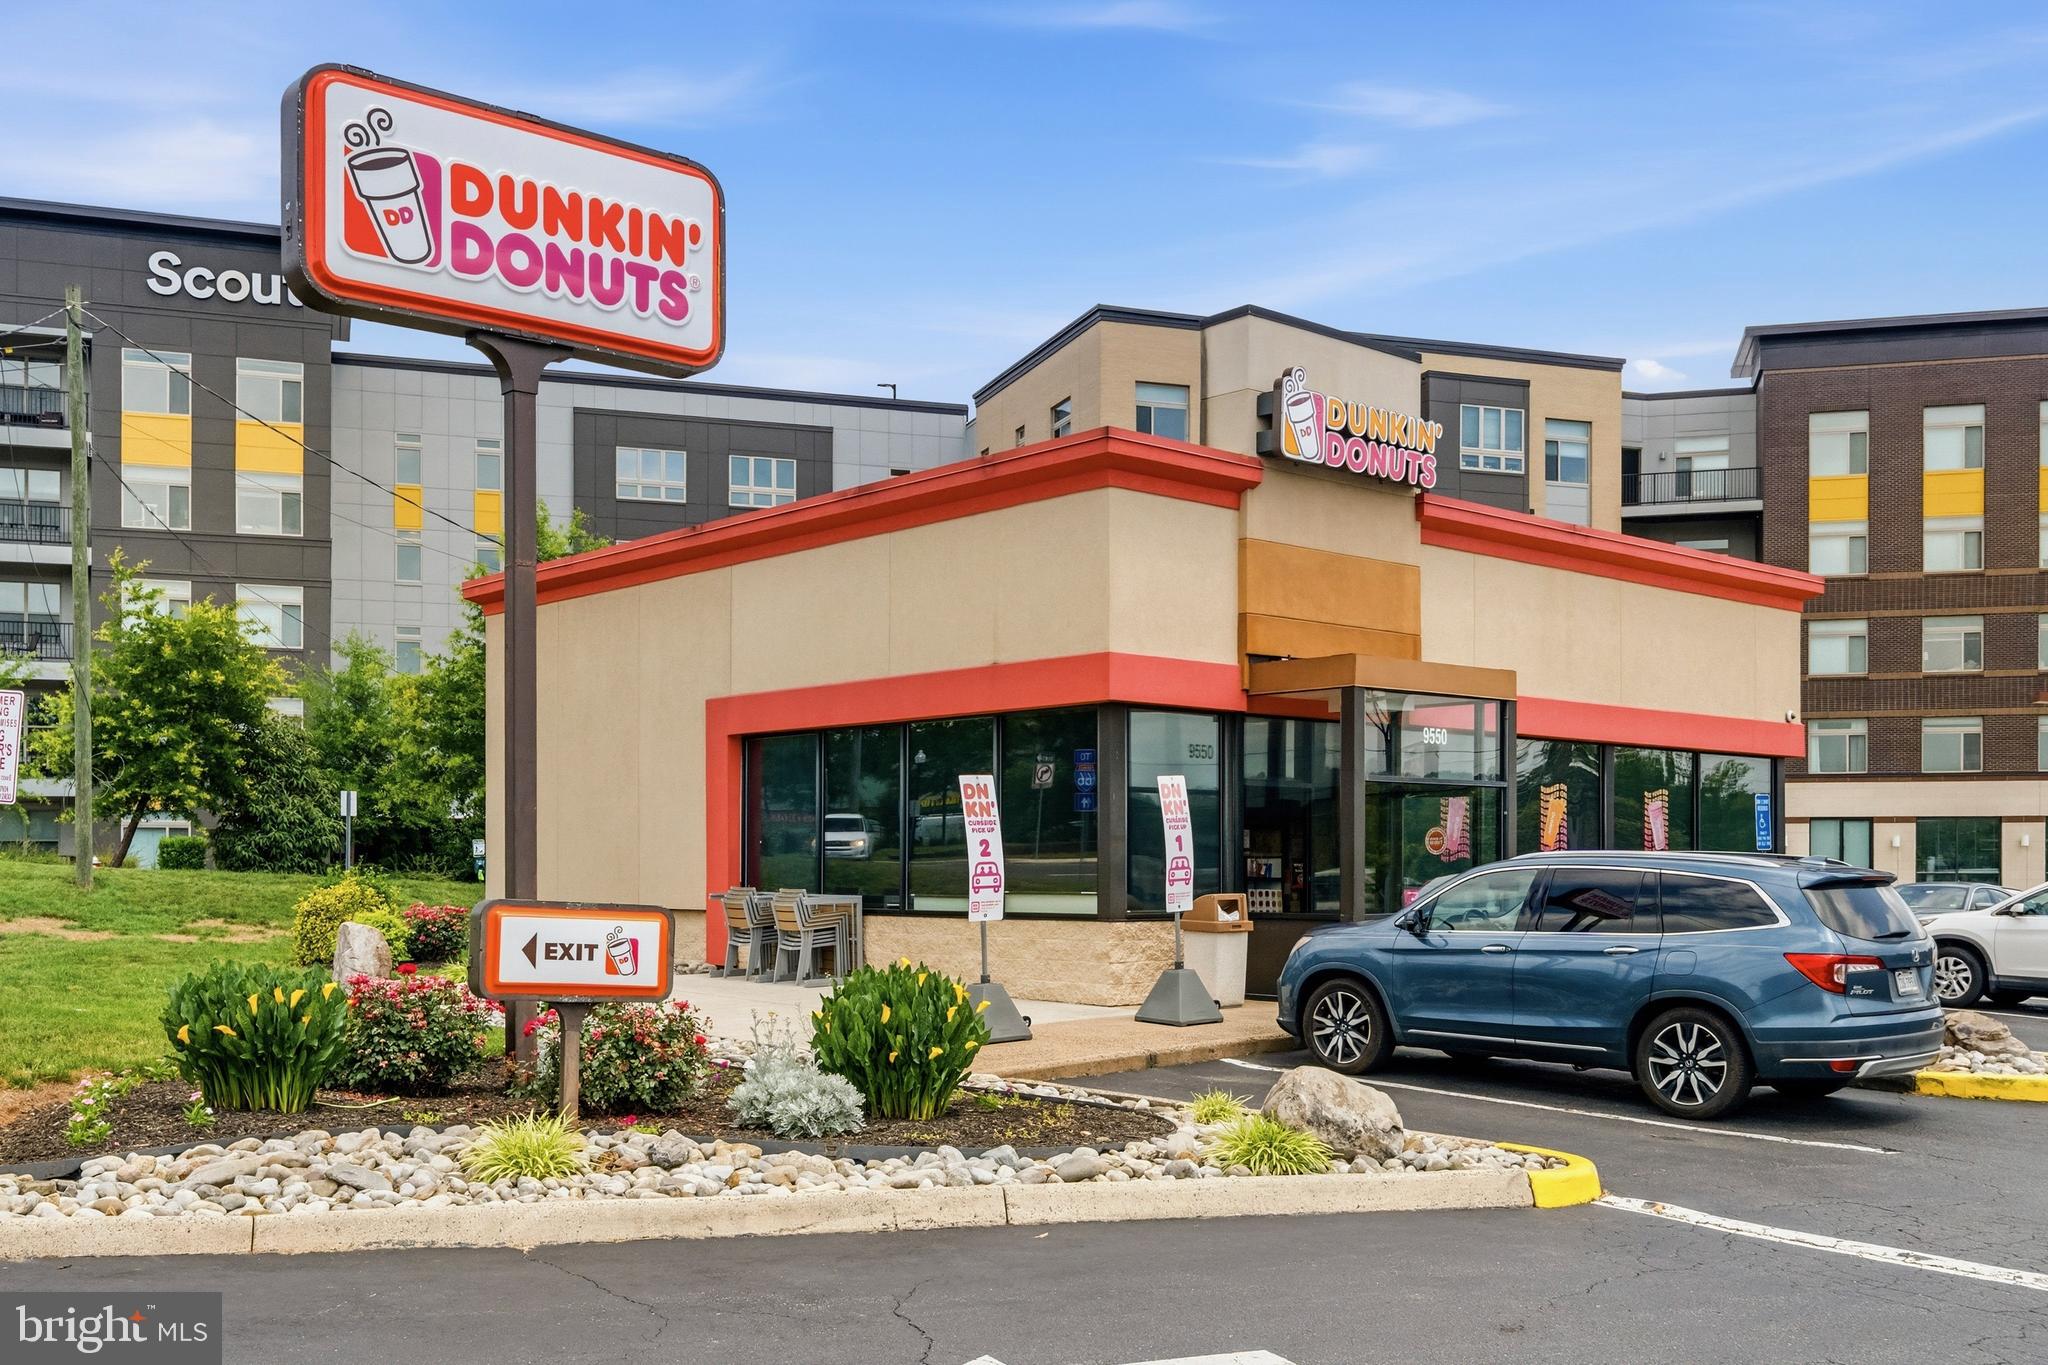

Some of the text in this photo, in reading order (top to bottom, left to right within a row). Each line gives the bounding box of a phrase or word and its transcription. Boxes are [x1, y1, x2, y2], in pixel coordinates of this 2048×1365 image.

[383, 207, 413, 226] DD
[450, 163, 700, 267] DUNKIN'
[451, 220, 689, 321] DONUTS
[1300, 426, 1311, 437] DD
[1327, 396, 1443, 453] DUNKIN'
[1325, 432, 1436, 488] DONUTS
[1423, 727, 1447, 745] 9550
[963, 783, 989, 800] DN
[1161, 783, 1182, 799] DN
[979, 838, 991, 857] 2
[1175, 834, 1183, 852] 1
[544, 942, 599, 961] EXIT
